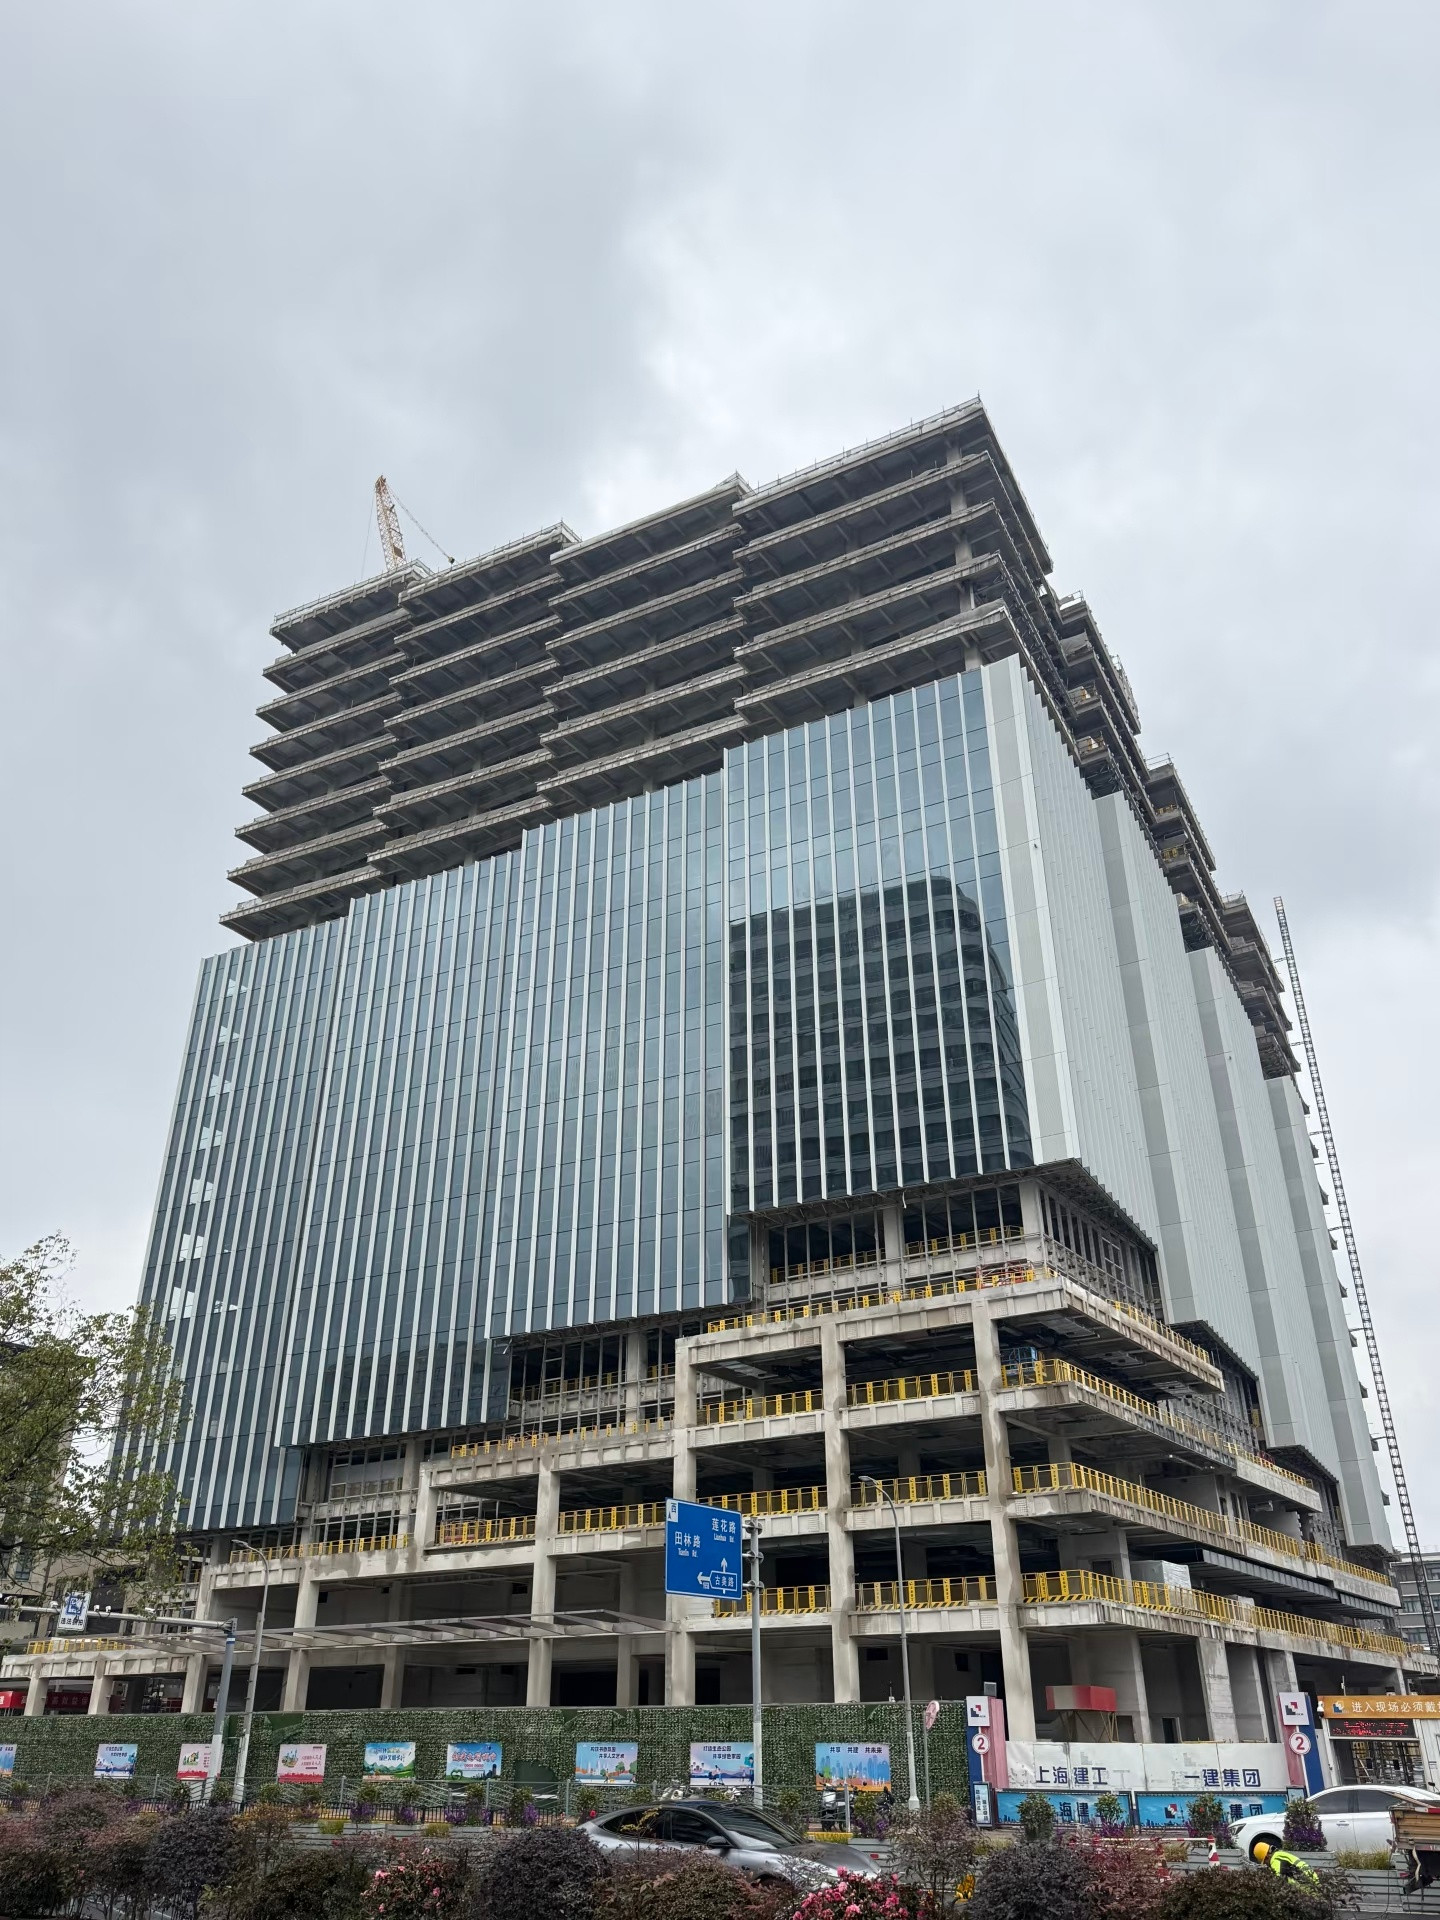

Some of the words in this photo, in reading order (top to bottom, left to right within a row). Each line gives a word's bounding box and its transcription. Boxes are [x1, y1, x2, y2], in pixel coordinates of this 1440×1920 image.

[711, 1518, 736, 1534] 莲花路
[675, 1532, 700, 1548] 田林路
[977, 1737, 985, 1750] 2
[1295, 1736, 1305, 1750] 2
[1036, 1766, 1108, 1785] 上海建工
[1184, 1768, 1261, 1787] 一建集团
